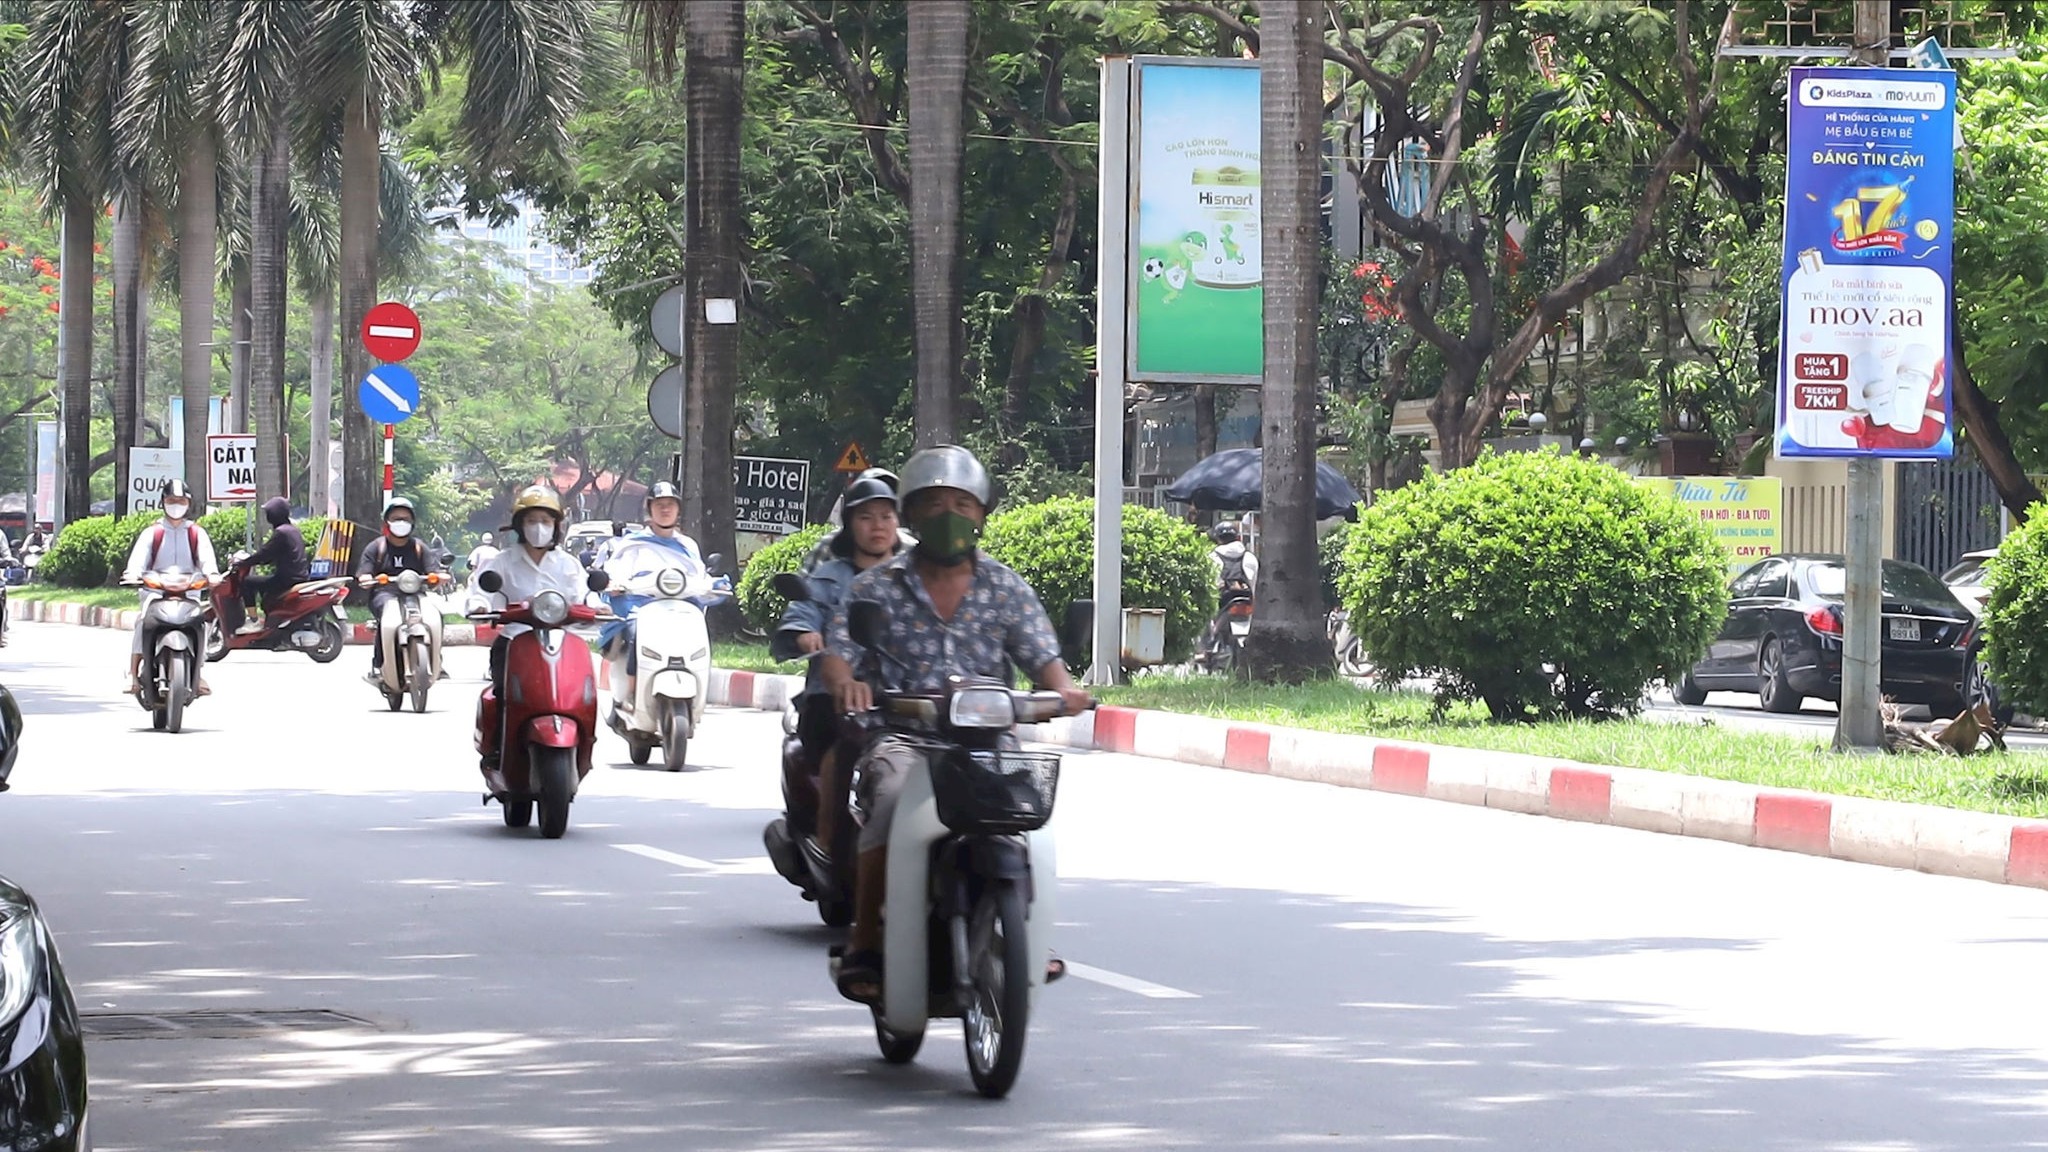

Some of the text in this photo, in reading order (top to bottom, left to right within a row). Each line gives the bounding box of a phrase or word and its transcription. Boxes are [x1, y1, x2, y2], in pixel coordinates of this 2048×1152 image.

[1827, 89, 1872, 99] KidsPlaza
[1825, 111, 1915, 124] HỆ THỐNG CỬA HÀNG
[1825, 124, 1913, 139] MẸ BẦU & EM BÉ
[1812, 149, 1925, 168] ĐÁNG TIN CẬY!
[1832, 185, 1906, 241] 17
[1810, 305, 1923, 328] mov.aa
[1803, 357, 1826, 366] MUA
[1829, 357, 1839, 376] 1
[1803, 367, 1831, 379] TẶNG
[1801, 387, 1842, 395] FREESHIP
[1804, 395, 1838, 408] 7KM
[214, 440, 246, 464] CẮT
[747, 461, 805, 491] Hotel
[778, 498, 785, 509] 3
[736, 507, 745, 518] 2
[1700, 509, 1714, 520] BIA
[1737, 509, 1750, 520] BIA
[1737, 546, 1756, 556] CAY
